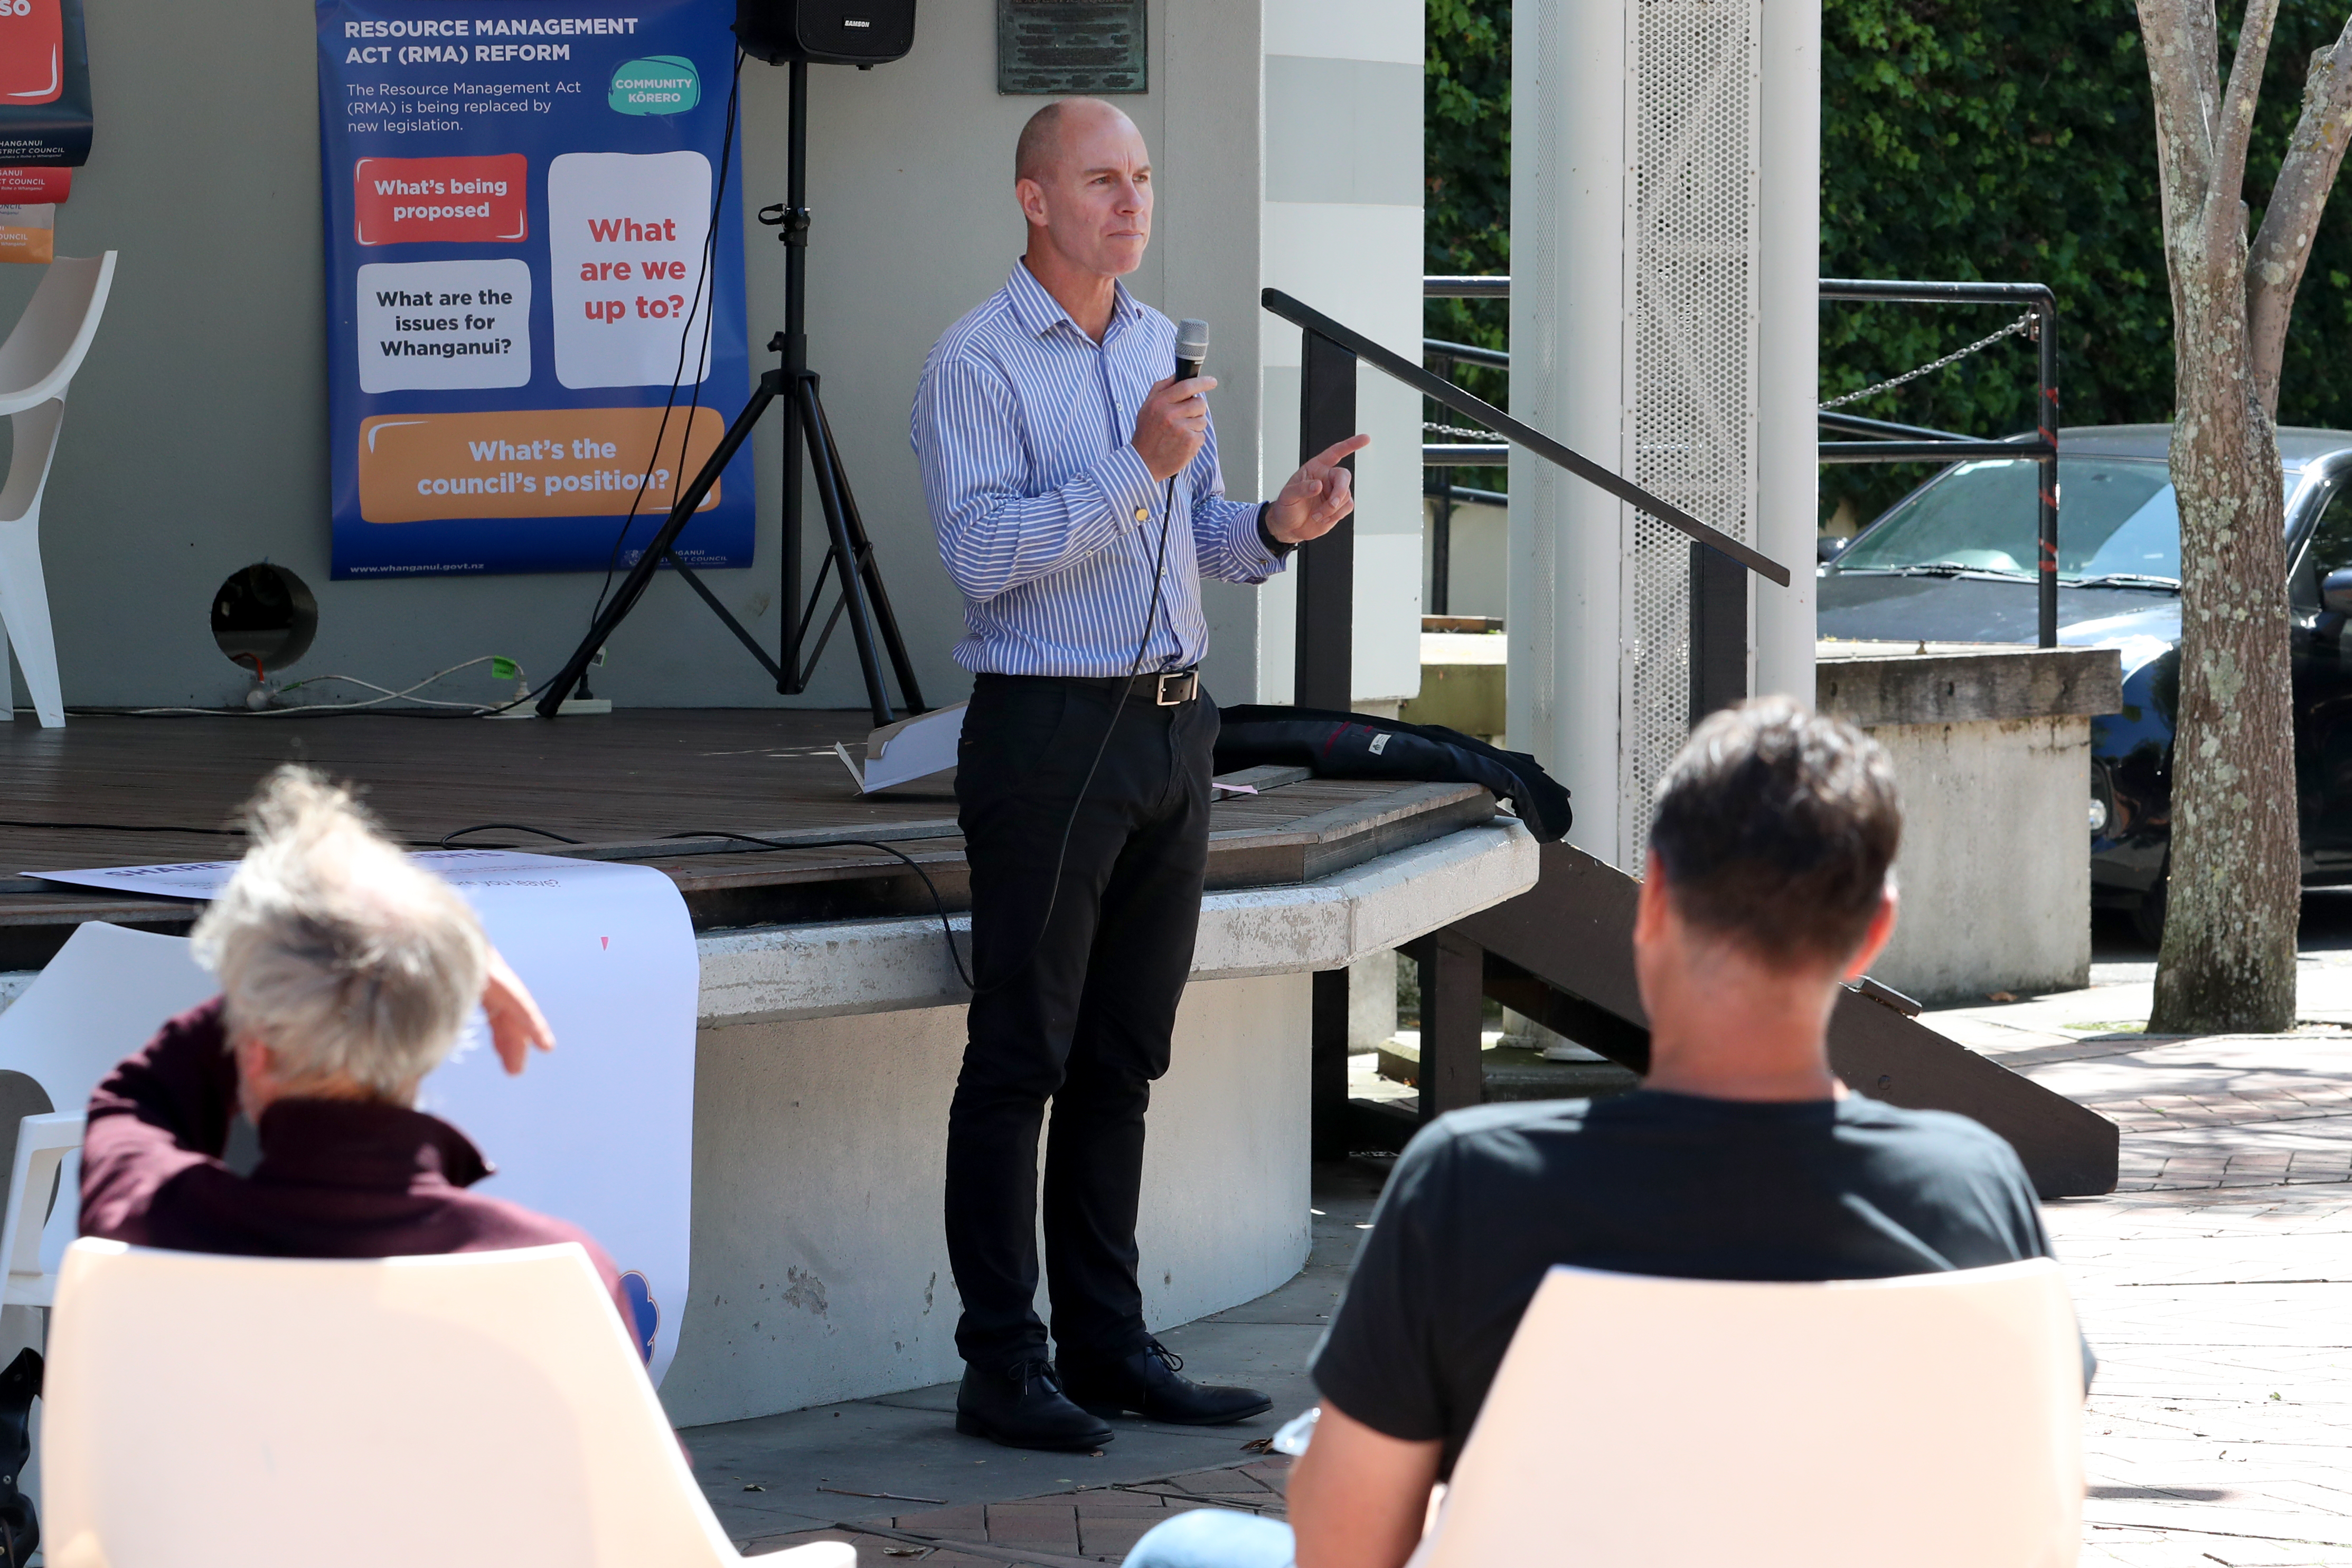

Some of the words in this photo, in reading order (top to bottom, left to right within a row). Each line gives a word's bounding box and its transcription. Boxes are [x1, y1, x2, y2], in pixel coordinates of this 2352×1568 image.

[345, 20, 469, 38] RESOURCE
[475, 18, 638, 36] MANAGEMENT
[345, 46, 392, 64] ACT
[398, 45, 468, 65] (RMA)
[475, 44, 570, 62] REFORM
[346, 83, 374, 96] The
[380, 83, 448, 96] Resource
[454, 81, 550, 96] Management
[555, 81, 581, 93] Act
[615, 79, 692, 89] COMMUNITY
[628, 91, 681, 103] KŌRERO
[347, 101, 396, 116] (RMA)
[401, 101, 412, 114] is
[418, 100, 459, 115] being
[464, 99, 528, 115] replaced
[533, 99, 551, 114] by
[348, 122, 379, 132] new
[384, 118, 463, 134] legislation.
[450, 178, 507, 196] being
[393, 202, 490, 222] proposed
[588, 217, 676, 242] What
[580, 262, 632, 281] are
[641, 261, 686, 280] we
[376, 290, 433, 307] What
[439, 293, 472, 306] are
[478, 289, 513, 305] the
[585, 300, 626, 324] up
[635, 294, 685, 319] to?
[396, 315, 459, 332] issues
[464, 314, 495, 330] for
[380, 338, 512, 358] Whanganui?
[571, 438, 617, 459] the
[544, 468, 670, 496] position?
[350, 563, 484, 573] www.whanganui.govt.nz
[106, 863, 228, 876] SHARE
[510, 879, 561, 887] leave?
